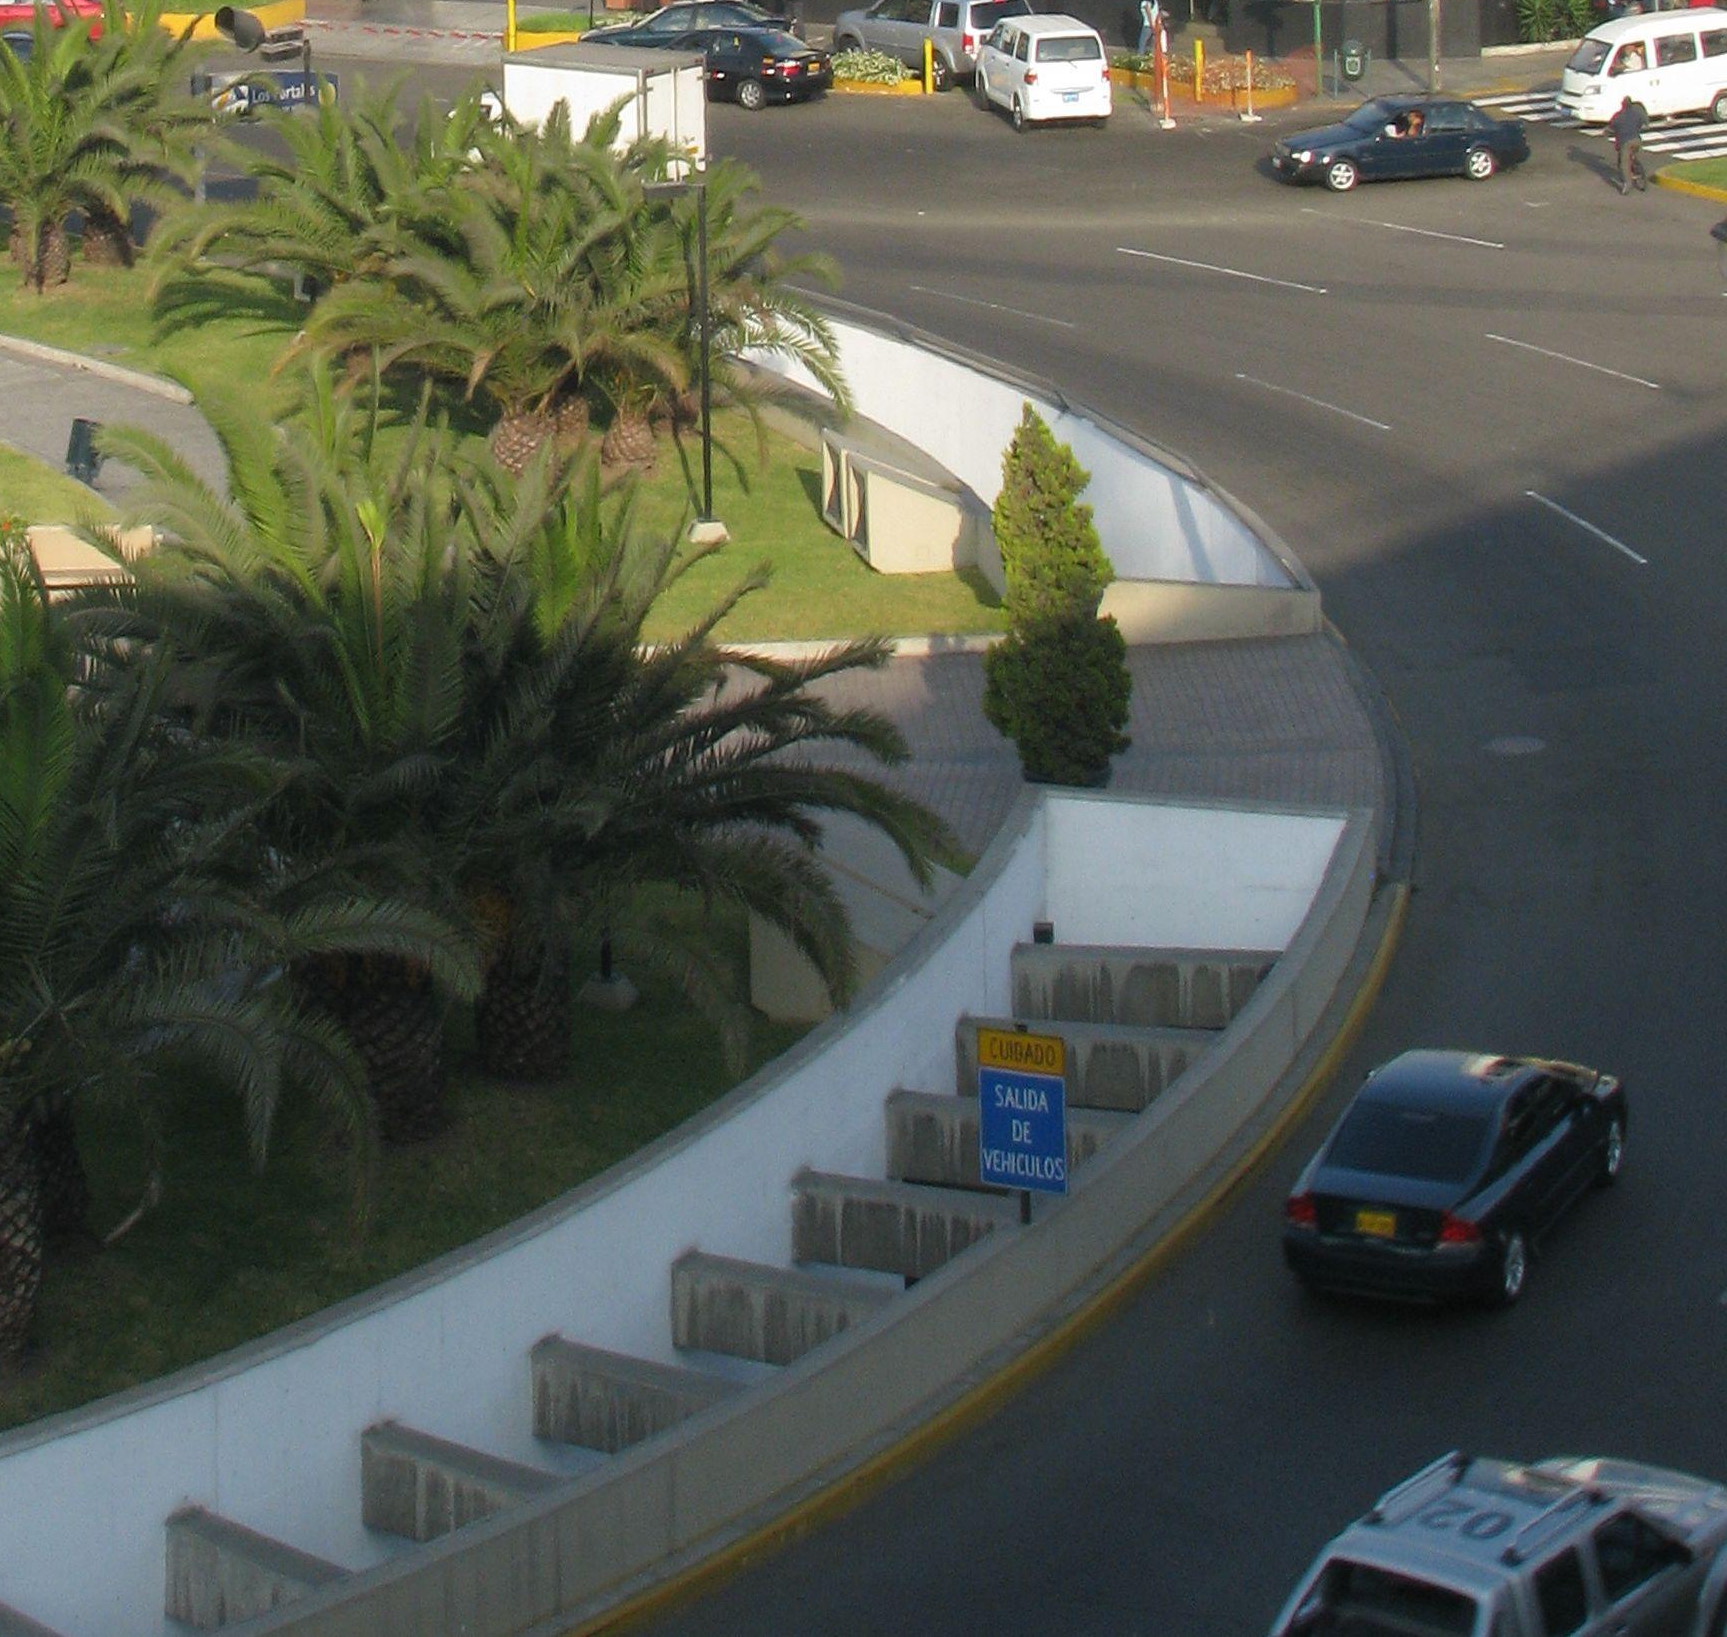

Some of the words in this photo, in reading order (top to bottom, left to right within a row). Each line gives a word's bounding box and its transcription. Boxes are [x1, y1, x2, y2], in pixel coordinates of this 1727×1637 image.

[252, 88, 271, 103] Los
[277, 83, 315, 101] ortals
[989, 1036, 1056, 1067] CUIDADO
[994, 1083, 1049, 1115] SALIDA
[1011, 1118, 1032, 1144] DE
[981, 1146, 1065, 1181] VEHICULOS
